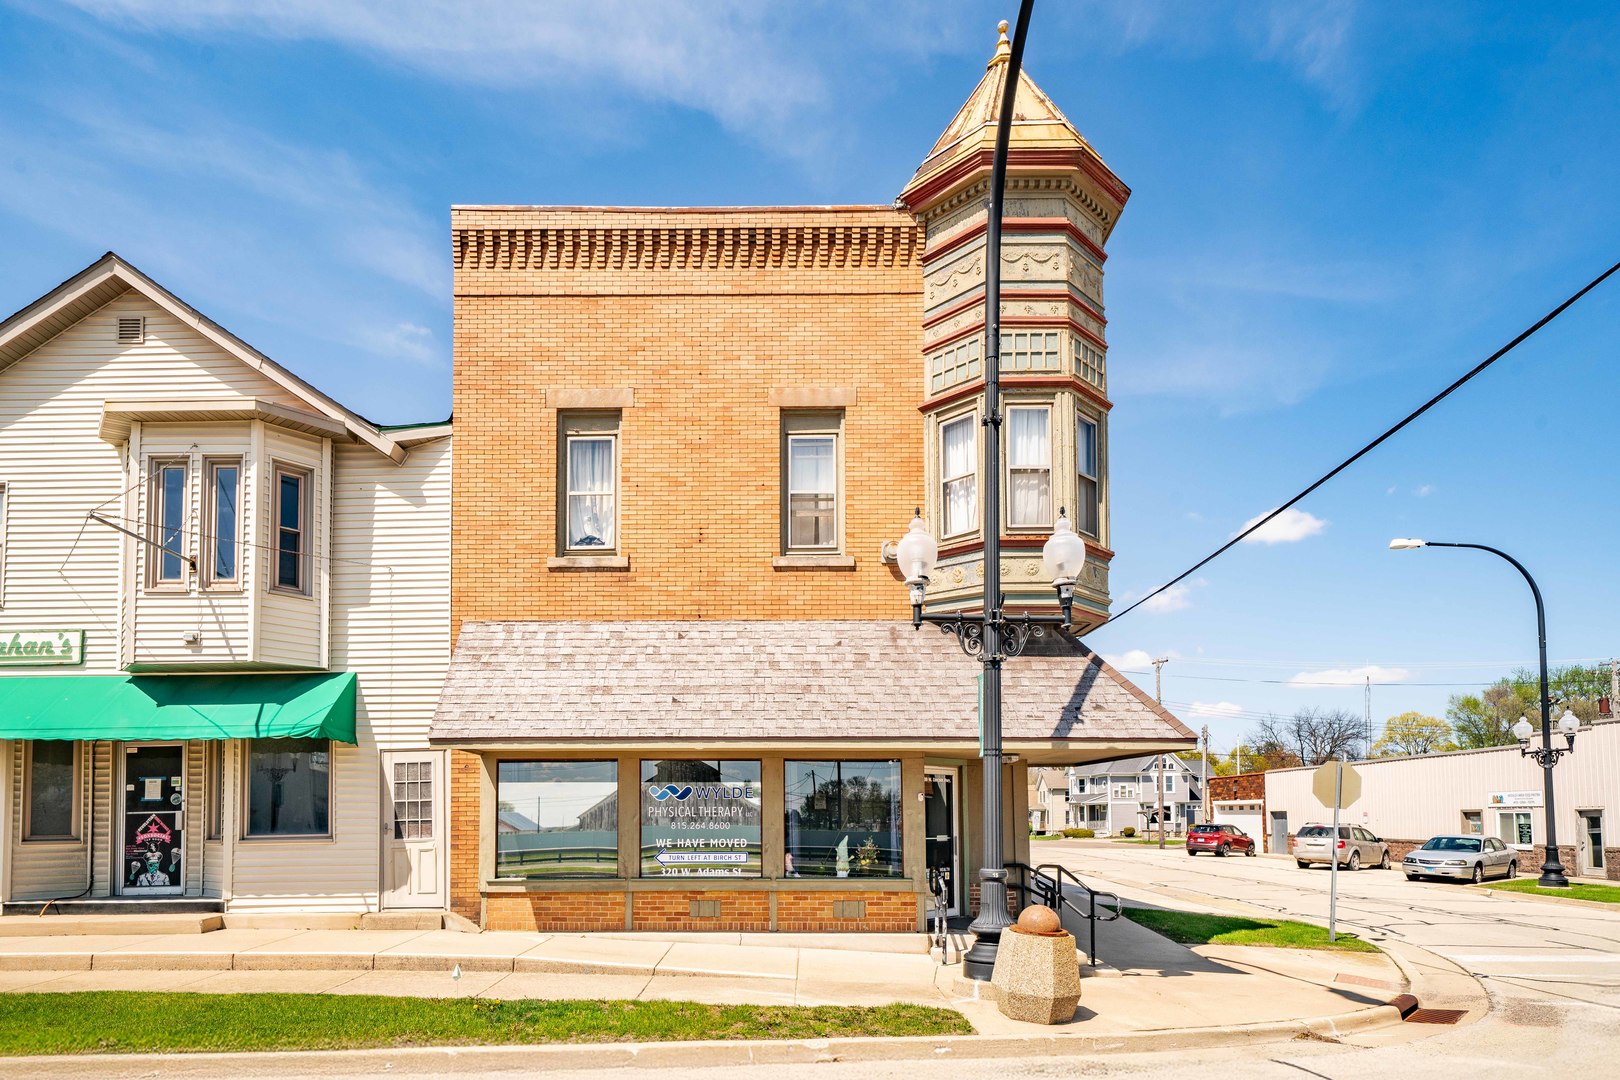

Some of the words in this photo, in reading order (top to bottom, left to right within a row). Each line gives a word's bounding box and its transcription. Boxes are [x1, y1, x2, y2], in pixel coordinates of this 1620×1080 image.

[695, 786, 754, 799] WYLDE
[648, 806, 696, 817] PHYSICAL
[699, 806, 744, 817] THERAPY
[670, 821, 731, 830] 815.264.8600
[656, 838, 672, 848] WE
[677, 838, 705, 848] HAVE
[710, 838, 748, 848] MOVED
[661, 868, 678, 876] 320
[697, 867, 729, 876] Adams
